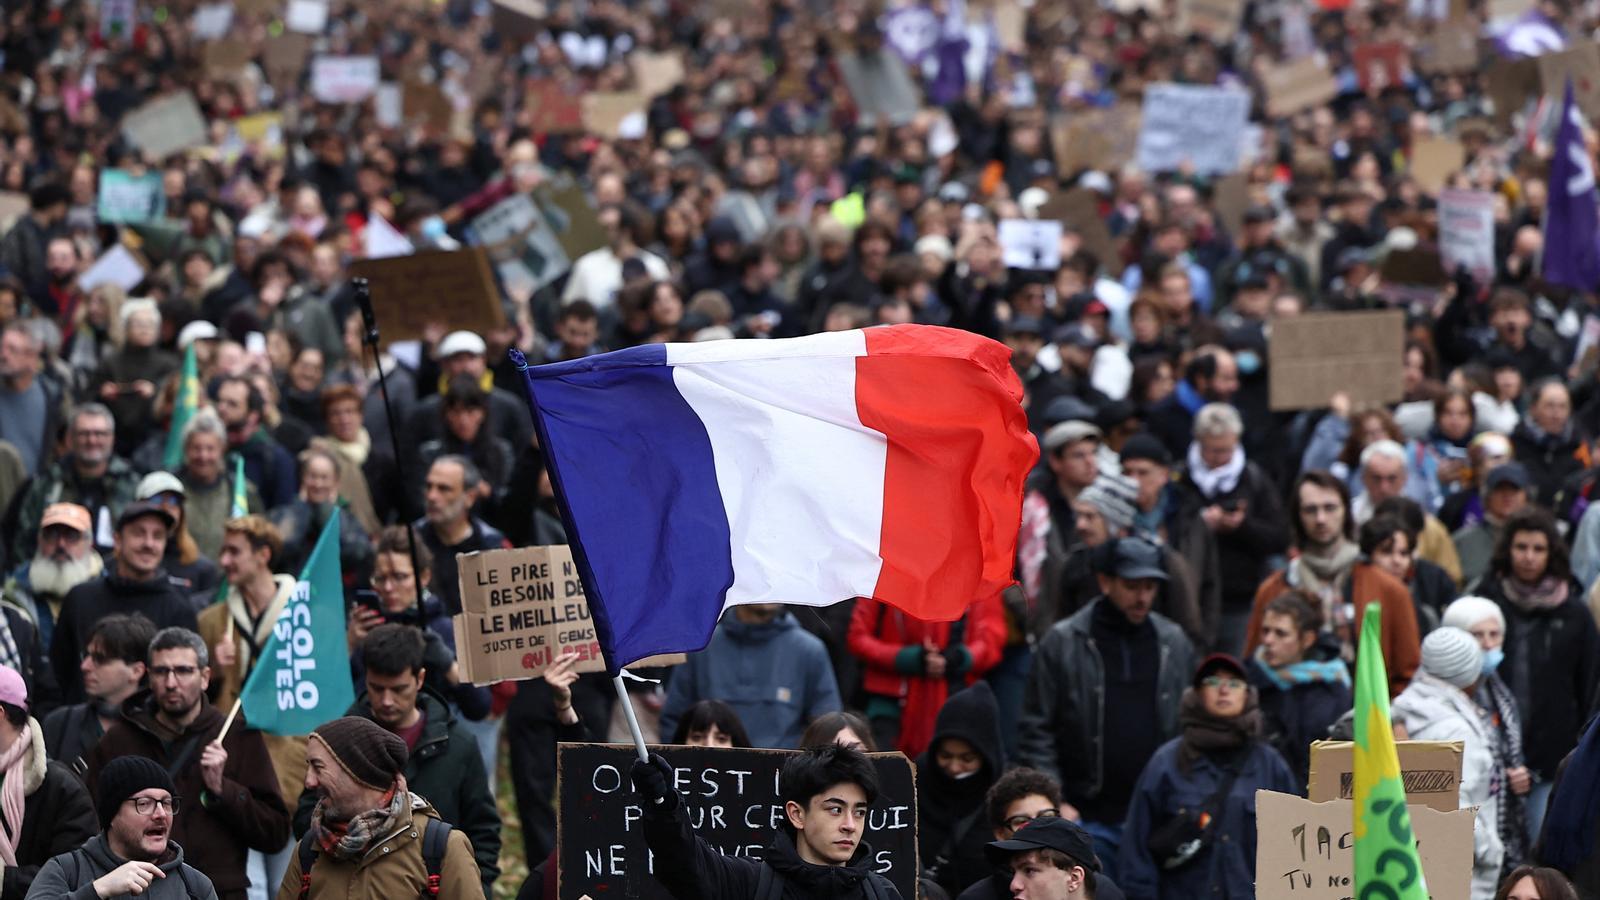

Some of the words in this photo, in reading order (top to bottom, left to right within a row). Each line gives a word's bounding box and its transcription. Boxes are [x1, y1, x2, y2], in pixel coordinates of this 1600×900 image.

[477, 569, 498, 586] LE
[480, 615, 504, 634] LE
[509, 603, 591, 632] MEILLEU
[482, 637, 525, 654] JUSTE
[529, 635, 545, 647] DE
[521, 646, 553, 669] QUI
[624, 804, 728, 832] PUR
